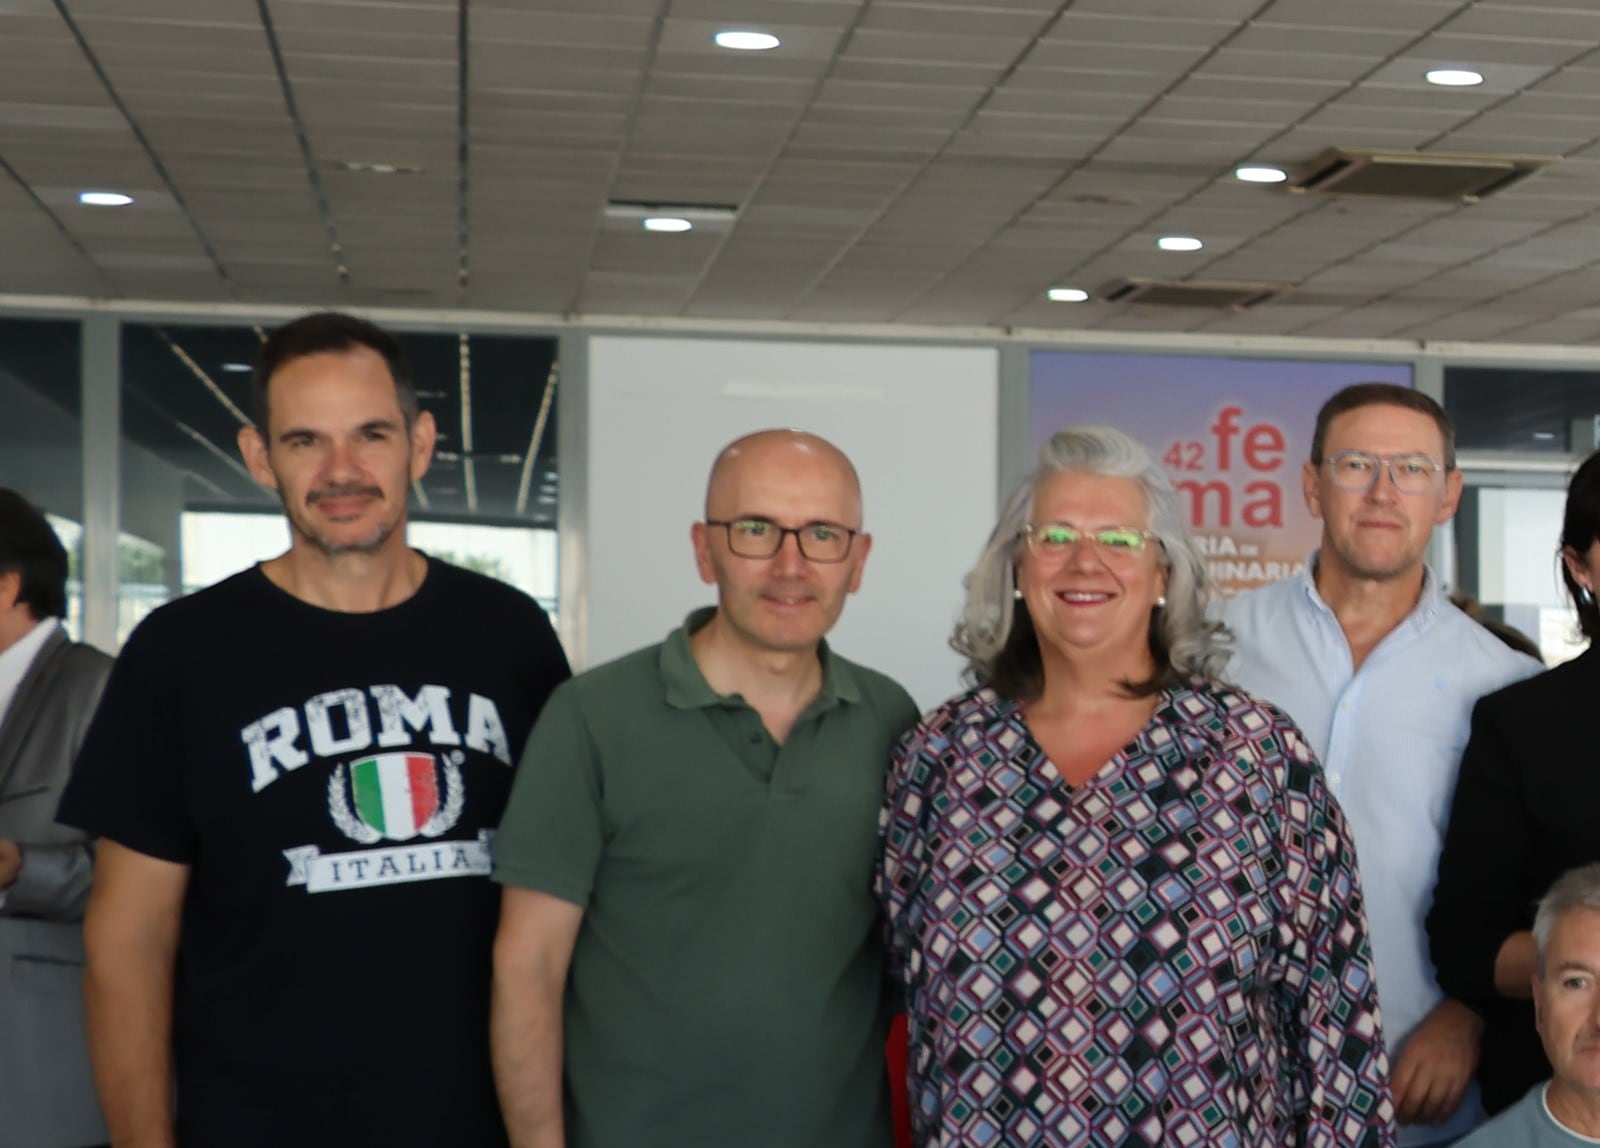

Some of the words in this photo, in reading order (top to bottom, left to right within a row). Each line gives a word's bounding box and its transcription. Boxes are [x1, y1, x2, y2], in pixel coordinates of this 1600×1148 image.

[1163, 441, 1205, 471] 42
[1211, 406, 1286, 472] fe
[1173, 479, 1285, 529] ma
[1192, 535, 1237, 555] RIA
[241, 683, 512, 793] ROMA
[330, 849, 472, 882] ITALIA
